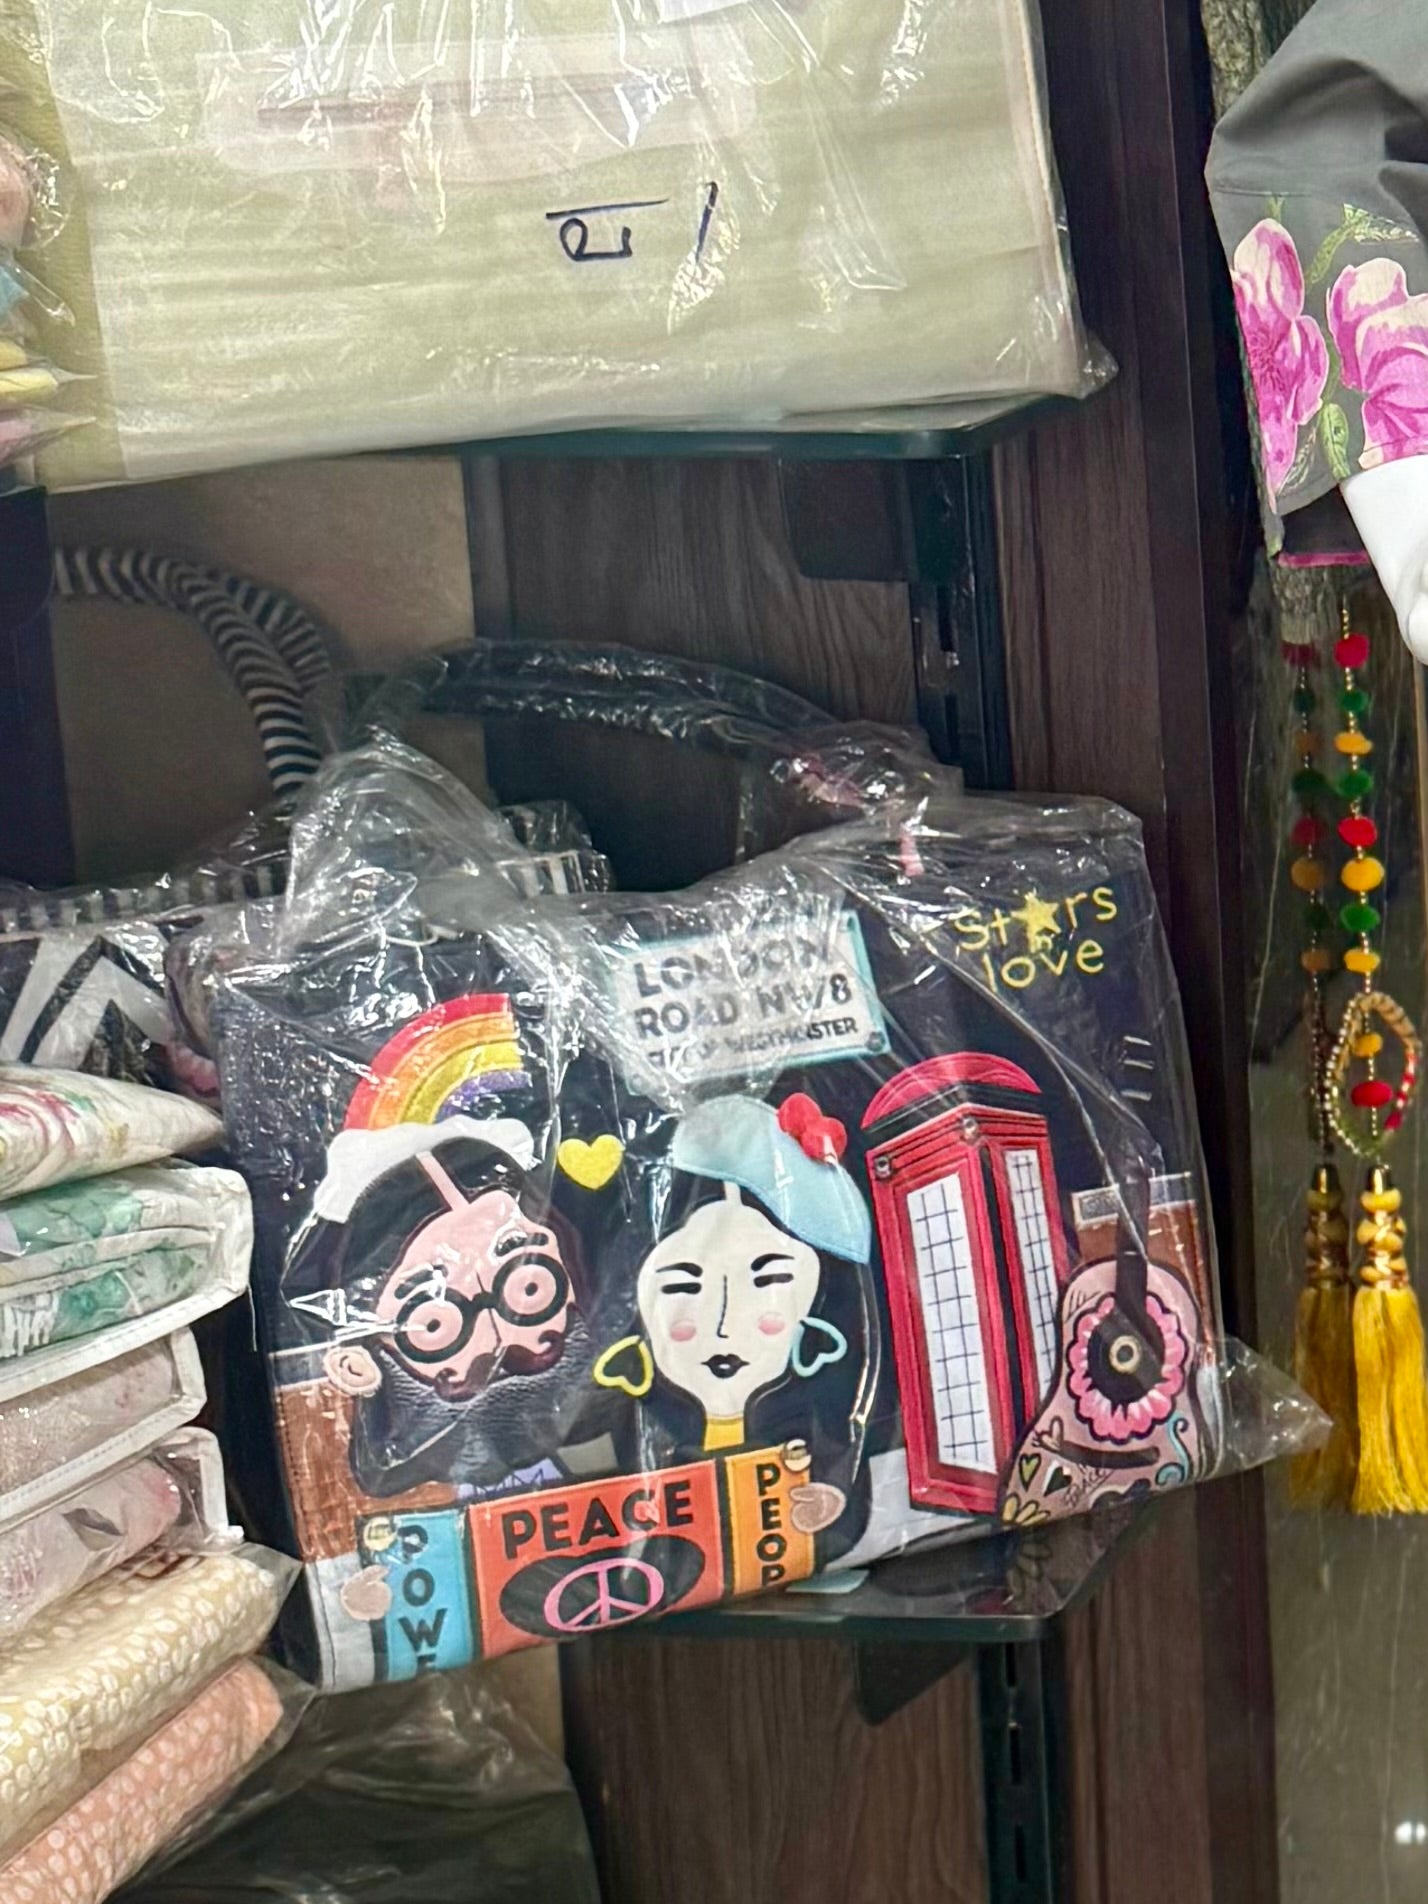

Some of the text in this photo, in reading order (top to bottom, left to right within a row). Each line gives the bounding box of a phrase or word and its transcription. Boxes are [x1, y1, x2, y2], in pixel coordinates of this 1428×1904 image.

[981, 939, 1105, 992] love
[634, 995, 739, 1040] ROAD
[501, 1479, 695, 1560] PEACE
